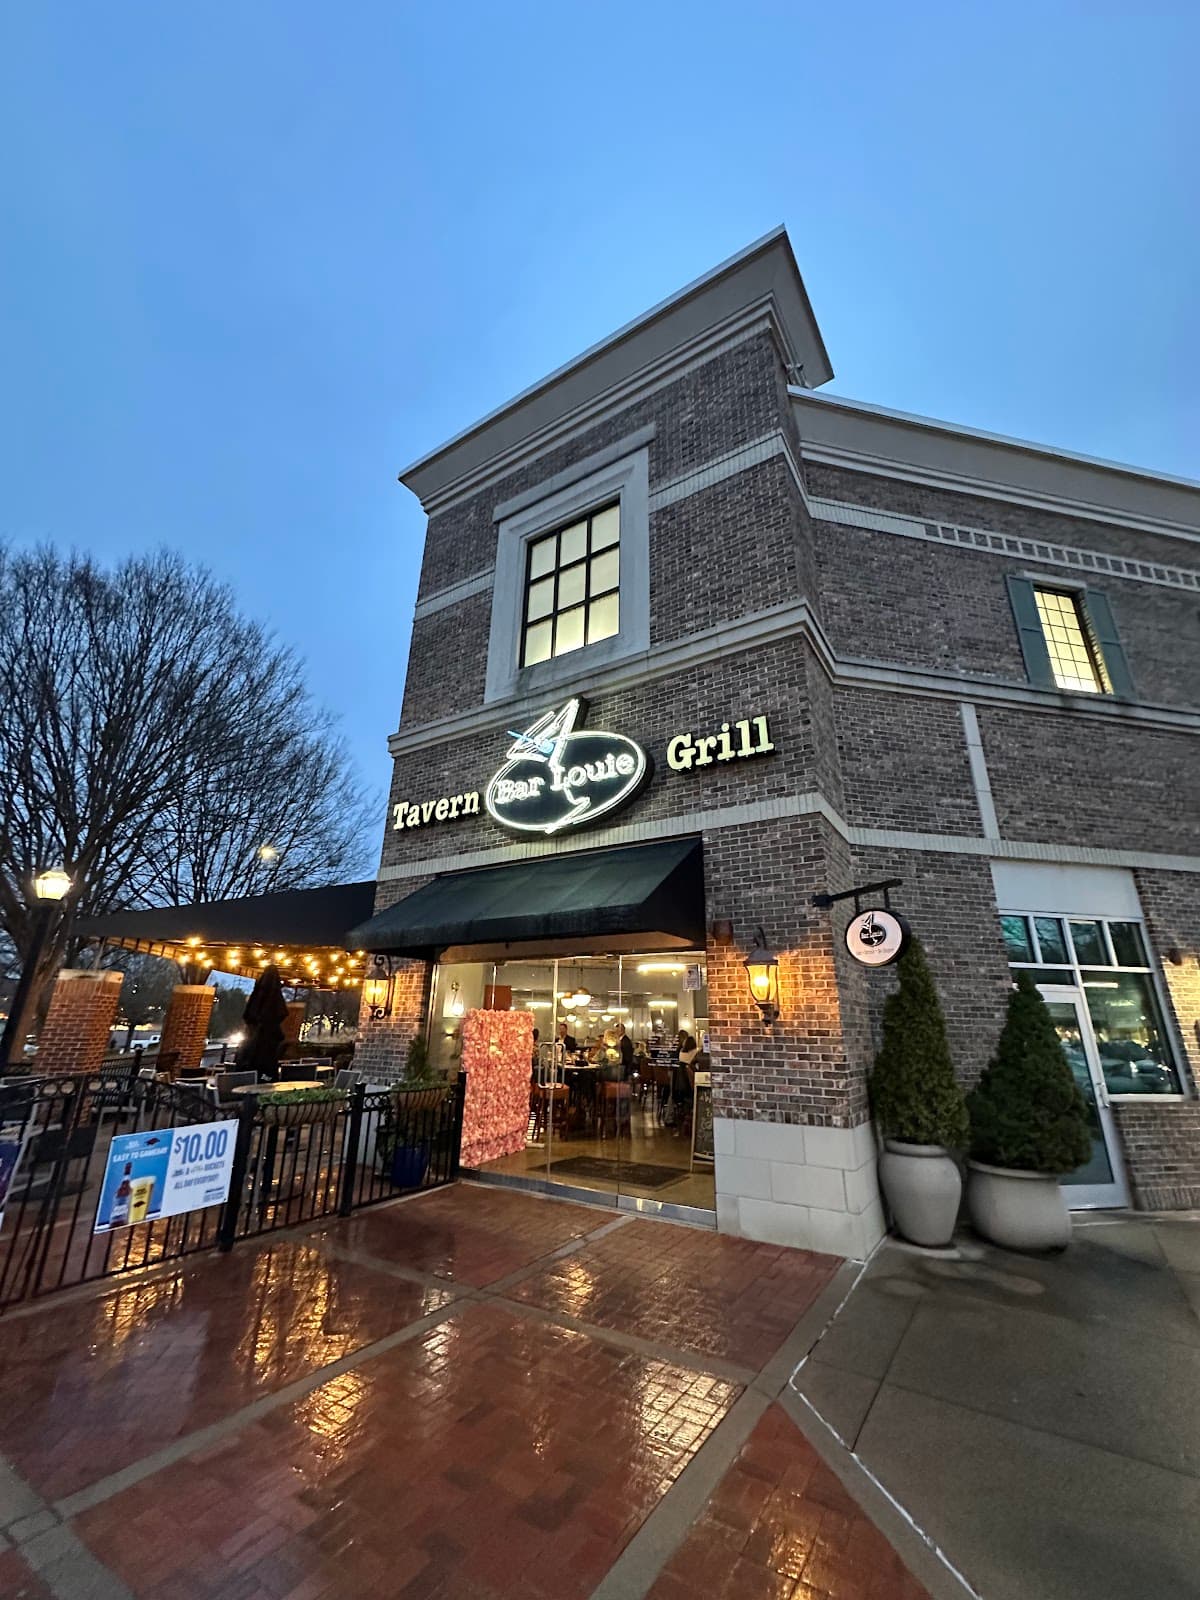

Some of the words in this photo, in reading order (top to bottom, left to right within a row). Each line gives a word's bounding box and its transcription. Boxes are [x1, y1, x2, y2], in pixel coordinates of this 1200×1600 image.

[666, 715, 774, 770] Grill
[495, 776, 545, 804] Bar
[550, 753, 635, 791] Louie
[392, 790, 480, 831] Tavern
[112, 1152, 130, 1163] EASY
[174, 1129, 228, 1164] $10.00
